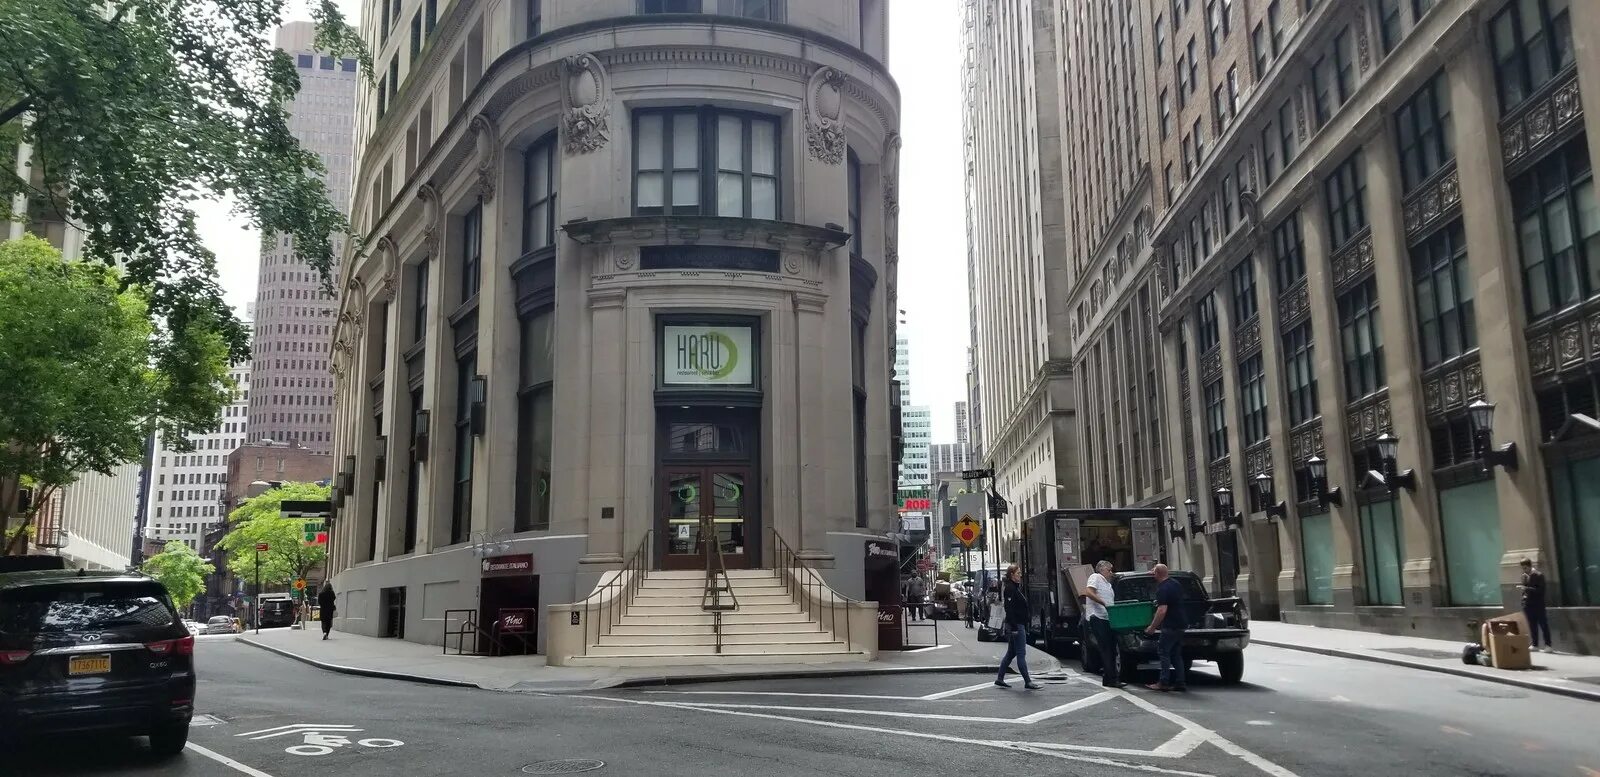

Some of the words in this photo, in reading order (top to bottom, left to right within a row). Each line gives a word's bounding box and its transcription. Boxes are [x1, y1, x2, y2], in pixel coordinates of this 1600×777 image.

[897, 489, 930, 499] ILLARNEY
[905, 499, 931, 510] ROSE
[680, 526, 688, 534] A
[504, 614, 523, 626] Fino
